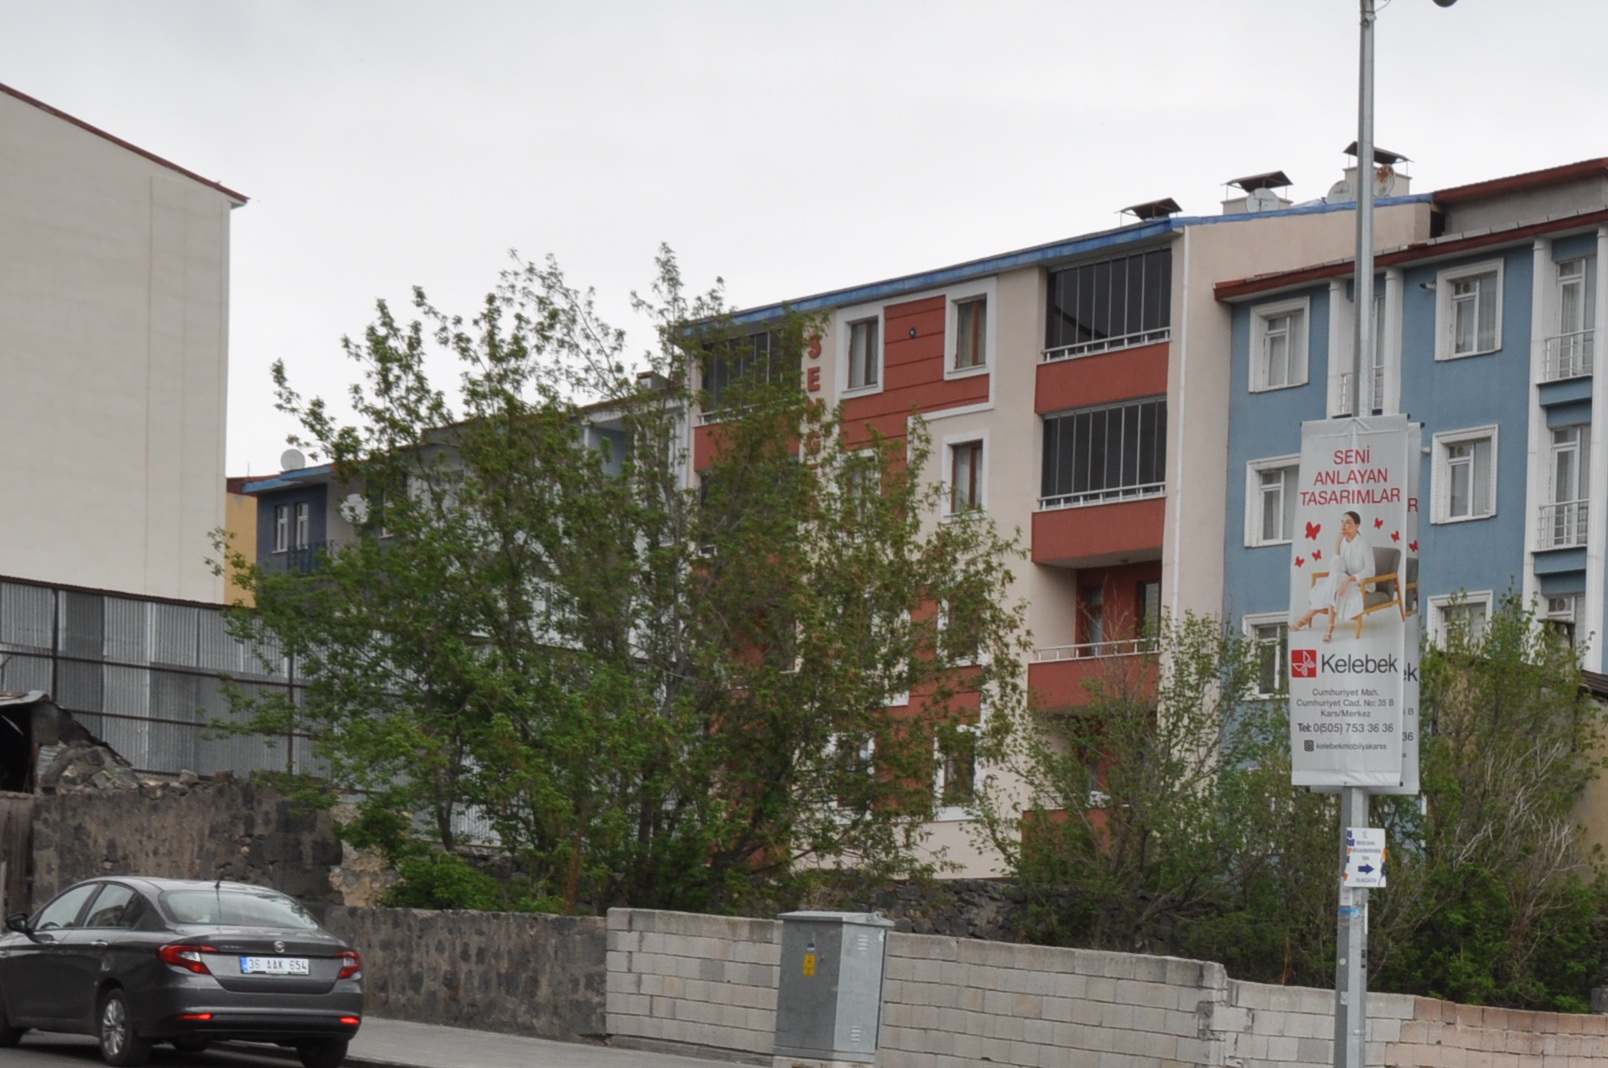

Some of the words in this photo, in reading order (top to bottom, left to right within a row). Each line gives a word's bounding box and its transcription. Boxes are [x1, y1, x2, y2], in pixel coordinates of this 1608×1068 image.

[1333, 445, 1371, 465] SENİ
[1313, 468, 1389, 486] ANLAYAN
[1301, 487, 1401, 506] TASARIMLAR
[1321, 653, 1398, 674] Kelebek
[1311, 687, 1359, 699] Cumhuriyet
[1360, 687, 1379, 697] Mah.
[1296, 699, 1341, 709] Cumhuriyet
[1343, 699, 1362, 707] Cad.
[1388, 699, 1395, 707] B
[1320, 709, 1372, 718] Kars/Merkez
[1313, 723, 1343, 734] 0(505)
[1345, 723, 1365, 733] 753
[1367, 723, 1380, 733] 36
[1381, 723, 1394, 733] 36
[249, 959, 261, 970] 36
[266, 959, 284, 970] AAK
[289, 960, 308, 971] 654
